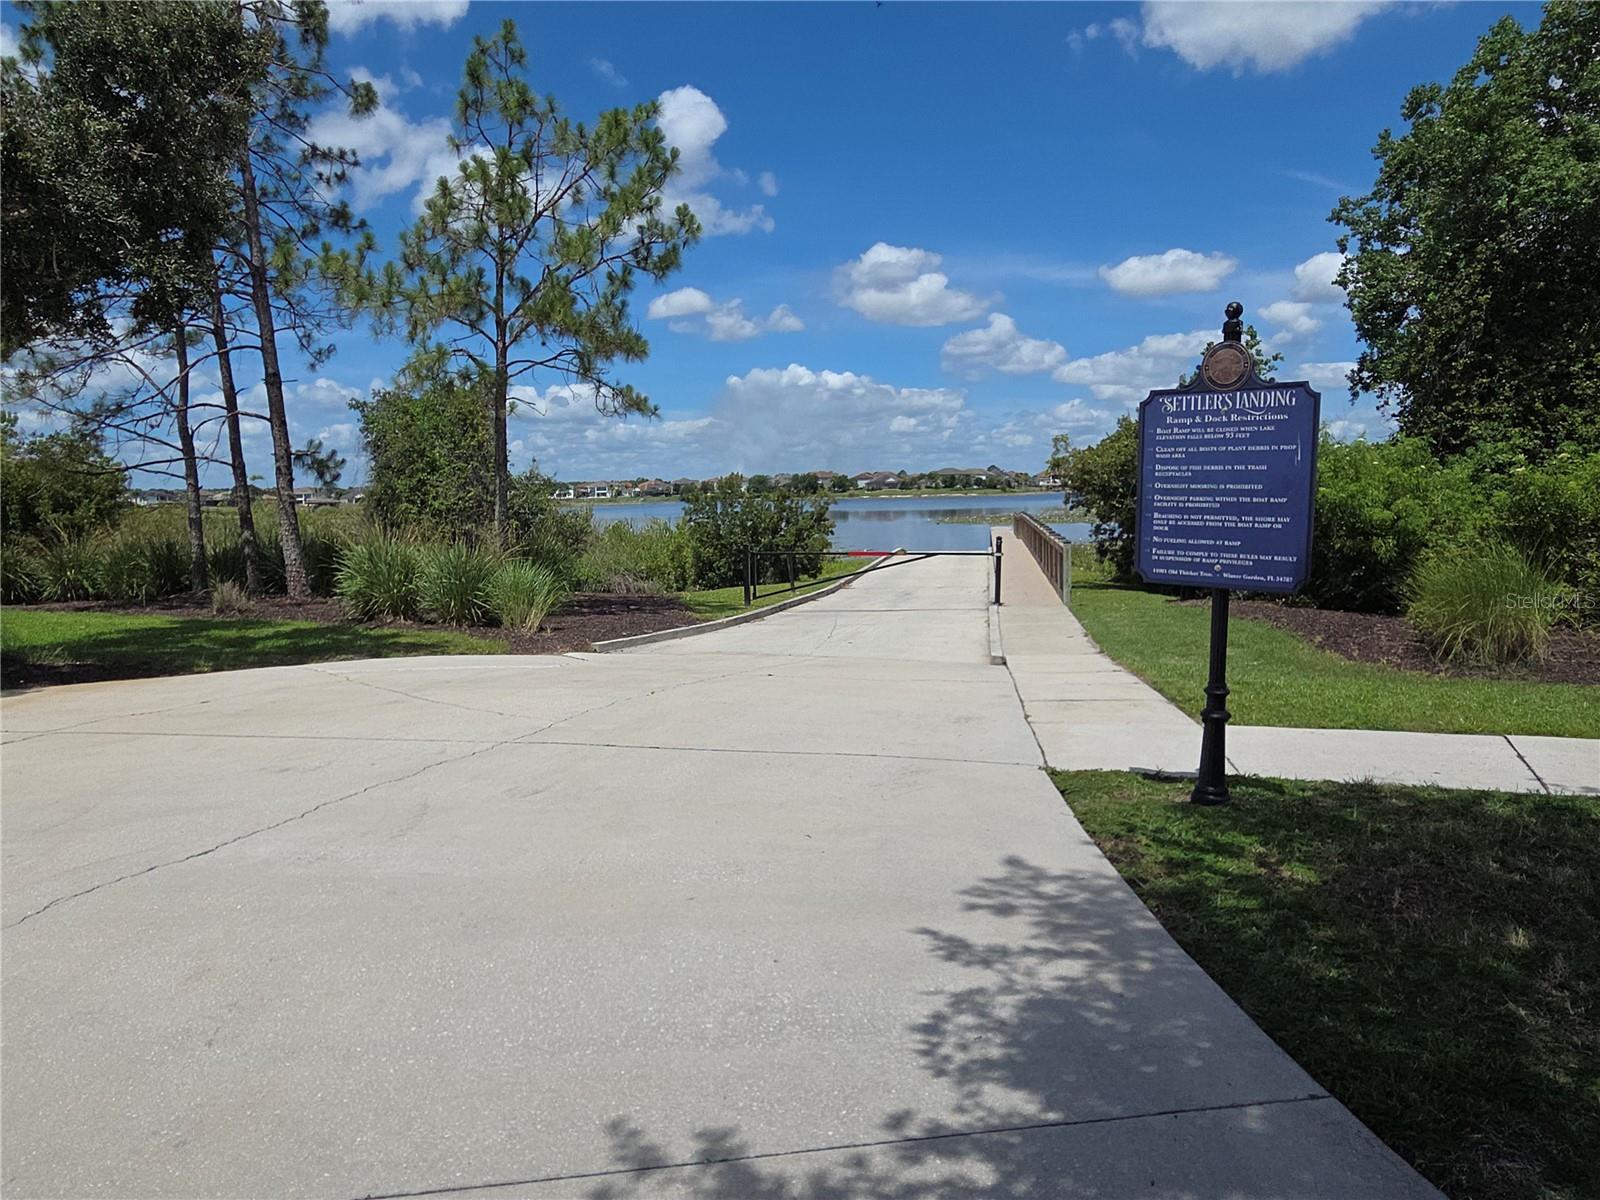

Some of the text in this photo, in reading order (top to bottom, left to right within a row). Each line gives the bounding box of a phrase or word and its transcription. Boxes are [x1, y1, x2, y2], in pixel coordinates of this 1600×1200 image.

[1160, 390, 1296, 414] SETTLER'S LANDING
[1166, 416, 1193, 425] Ramp
[1231, 412, 1288, 421] Restrictions
